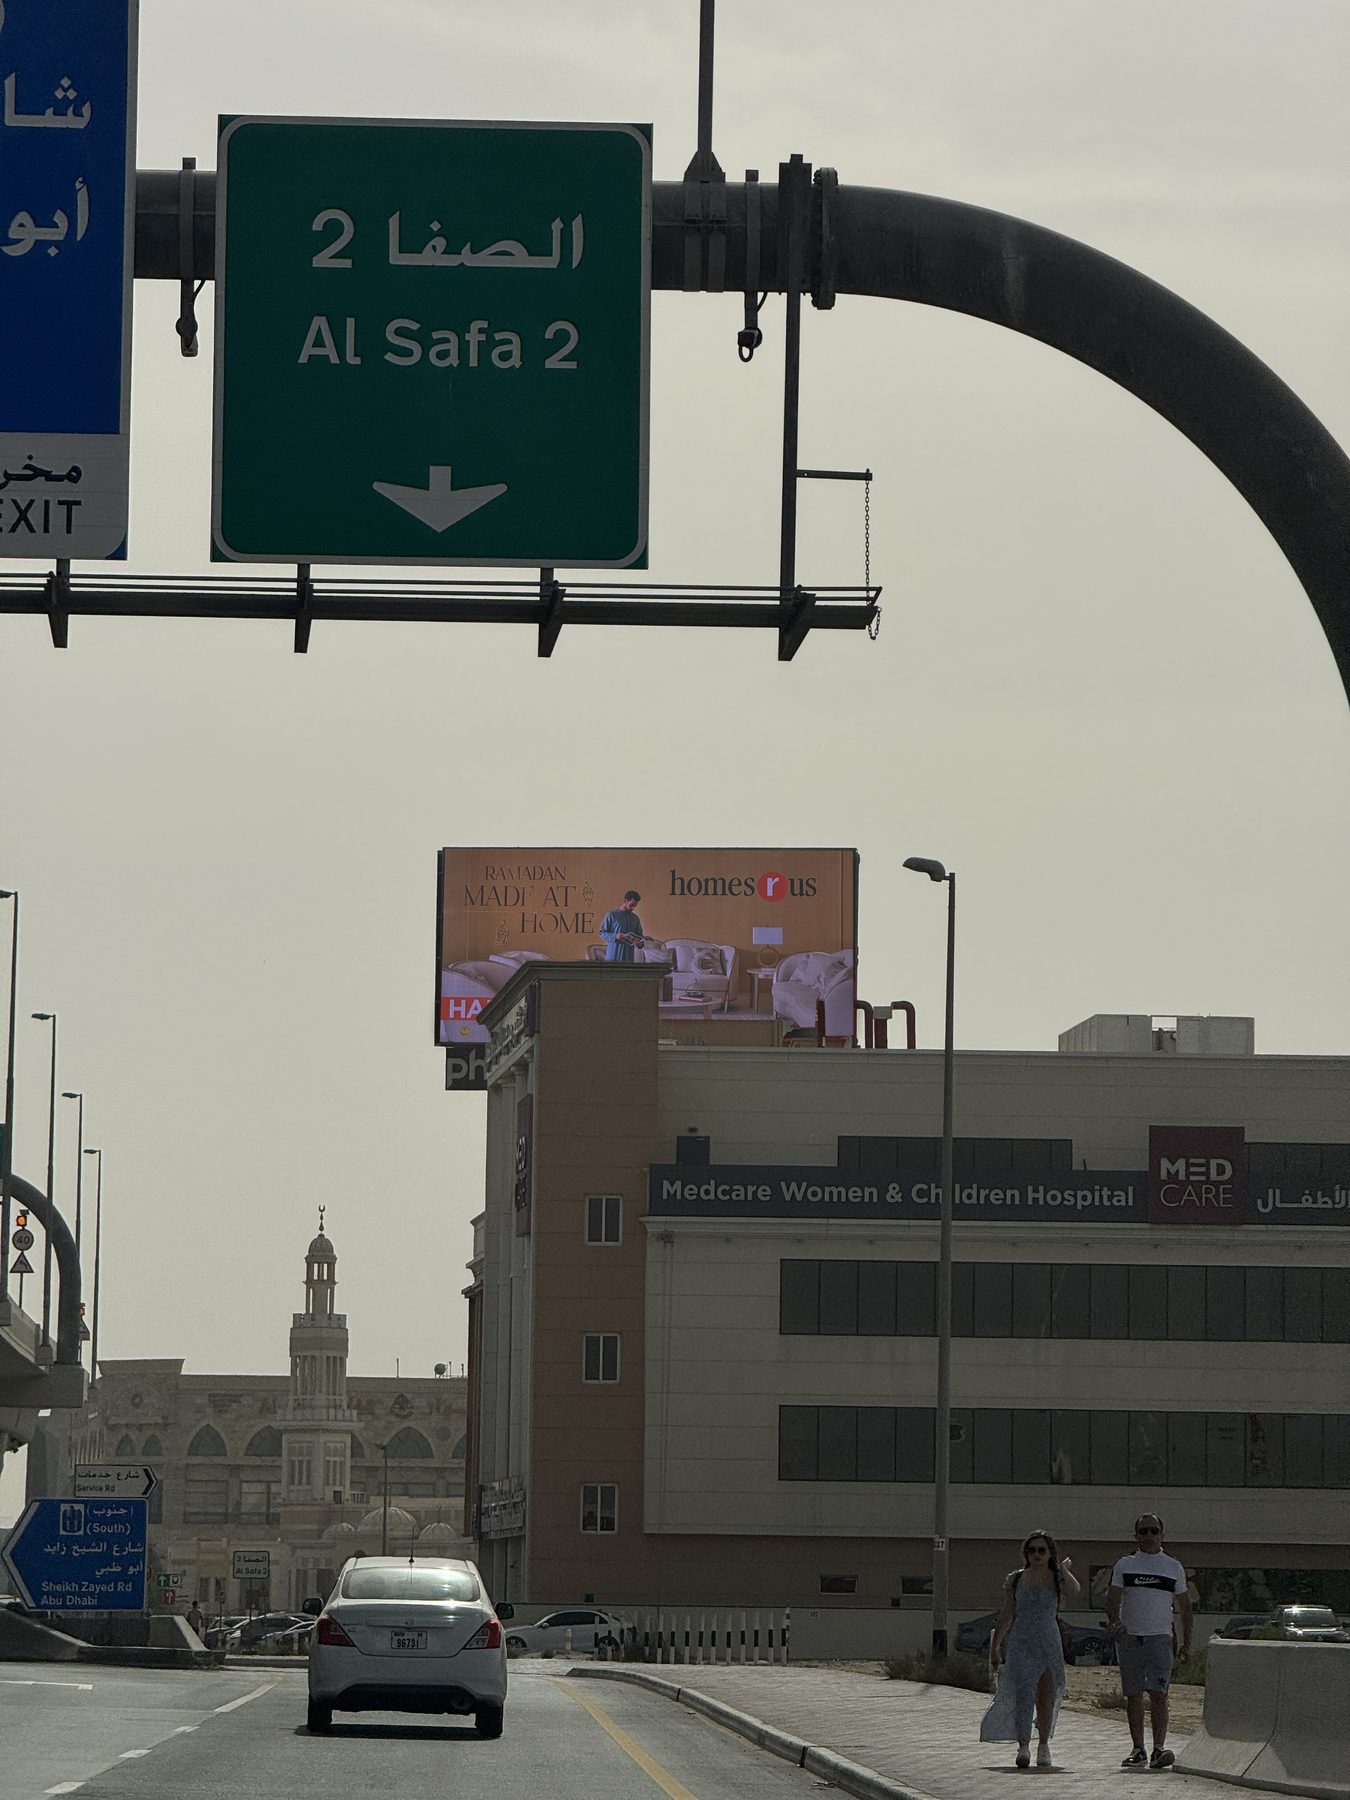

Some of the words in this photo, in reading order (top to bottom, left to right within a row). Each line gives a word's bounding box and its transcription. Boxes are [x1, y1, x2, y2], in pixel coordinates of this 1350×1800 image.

[0, 176, 89, 257] أبو
[311, 209, 356, 269] 2
[389, 211, 585, 269] الصفا
[298, 316, 361, 365] Al
[384, 318, 522, 368] Safa
[545, 320, 579, 369] 2
[0, 498, 82, 534] XIT
[485, 865, 567, 881] RAMADAN
[669, 868, 755, 897] homes
[766, 876, 780, 897] r
[788, 876, 817, 897] us
[463, 885, 534, 907] MADE
[543, 885, 577, 907] AT
[520, 911, 595, 934] HOME
[1160, 1157, 1233, 1181] MED
[661, 1179, 772, 1201] Medcare
[780, 1180, 878, 1203] Women
[885, 1182, 903, 1203] &
[911, 1183, 1020, 1206] Chldren
[1027, 1184, 1134, 1210] Hospital
[1160, 1184, 1233, 1208] CARE
[17, 1236, 30, 1244] 40
[116, 1470, 140, 1481] شارع
[76, 1484, 103, 1493] Service
[105, 1484, 115, 1493] Rd
[86, 1522, 131, 1535] (South)
[43, 1541, 66, 1555] زايد
[71, 1541, 107, 1556] الشيخ
[112, 1542, 144, 1556] شارع
[95, 1562, 122, 1577] ظبي
[41, 1581, 79, 1592] Sheikh
[81, 1581, 114, 1593] Zayed
[117, 1581, 132, 1592] Rd
[40, 1595, 63, 1606] Abu
[66, 1595, 98, 1606] Dhabi
